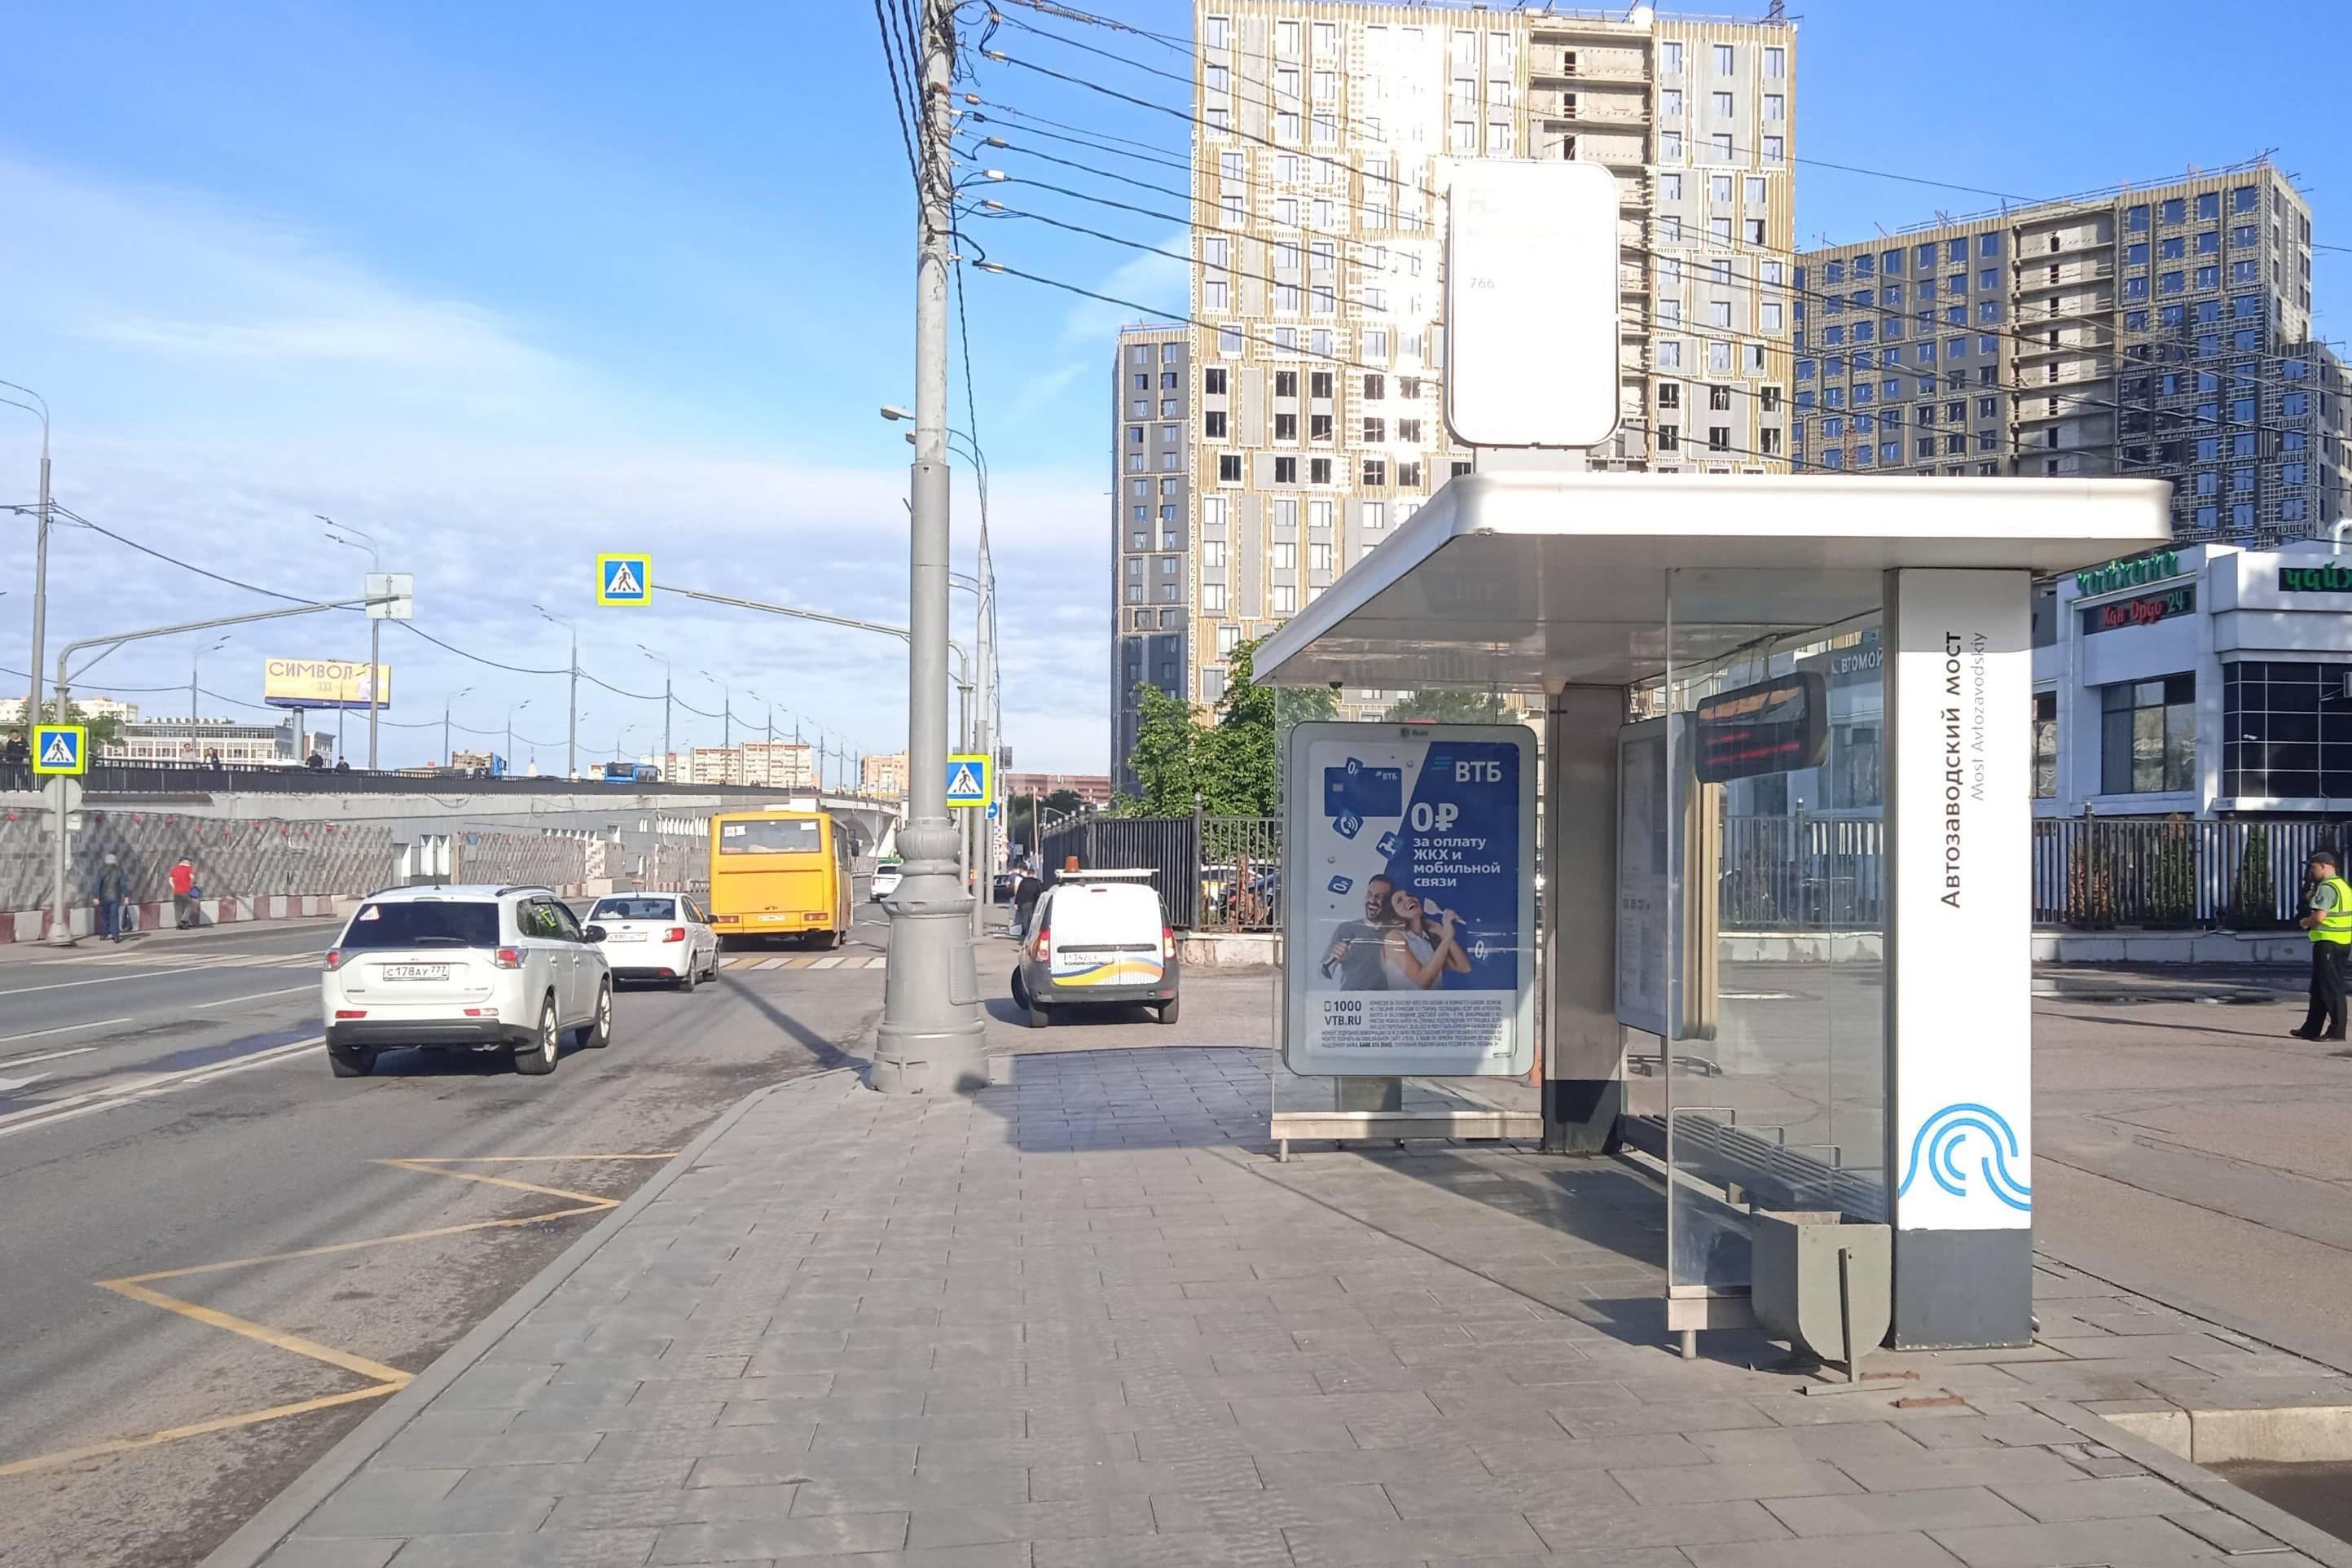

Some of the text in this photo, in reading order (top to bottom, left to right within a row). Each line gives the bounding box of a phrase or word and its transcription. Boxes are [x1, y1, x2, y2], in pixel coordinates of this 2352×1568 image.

[1470, 277, 1495, 289] 766
[2167, 591, 2184, 613] 24
[269, 662, 352, 680] СИМВОЛ
[1970, 631, 1988, 801] Most Avtozavodskiy
[1455, 761, 1502, 783] ВТБ
[1941, 631, 1963, 908] Автозаводский мост
[1413, 838, 1486, 850] за оплату
[1413, 849, 1462, 861] ЖКХ и
[1413, 861, 1501, 874] мобильной
[1413, 876, 1457, 887] связи
[1334, 1000, 1362, 1012] 1000
[1325, 1016, 1362, 1026] VTB.RU
